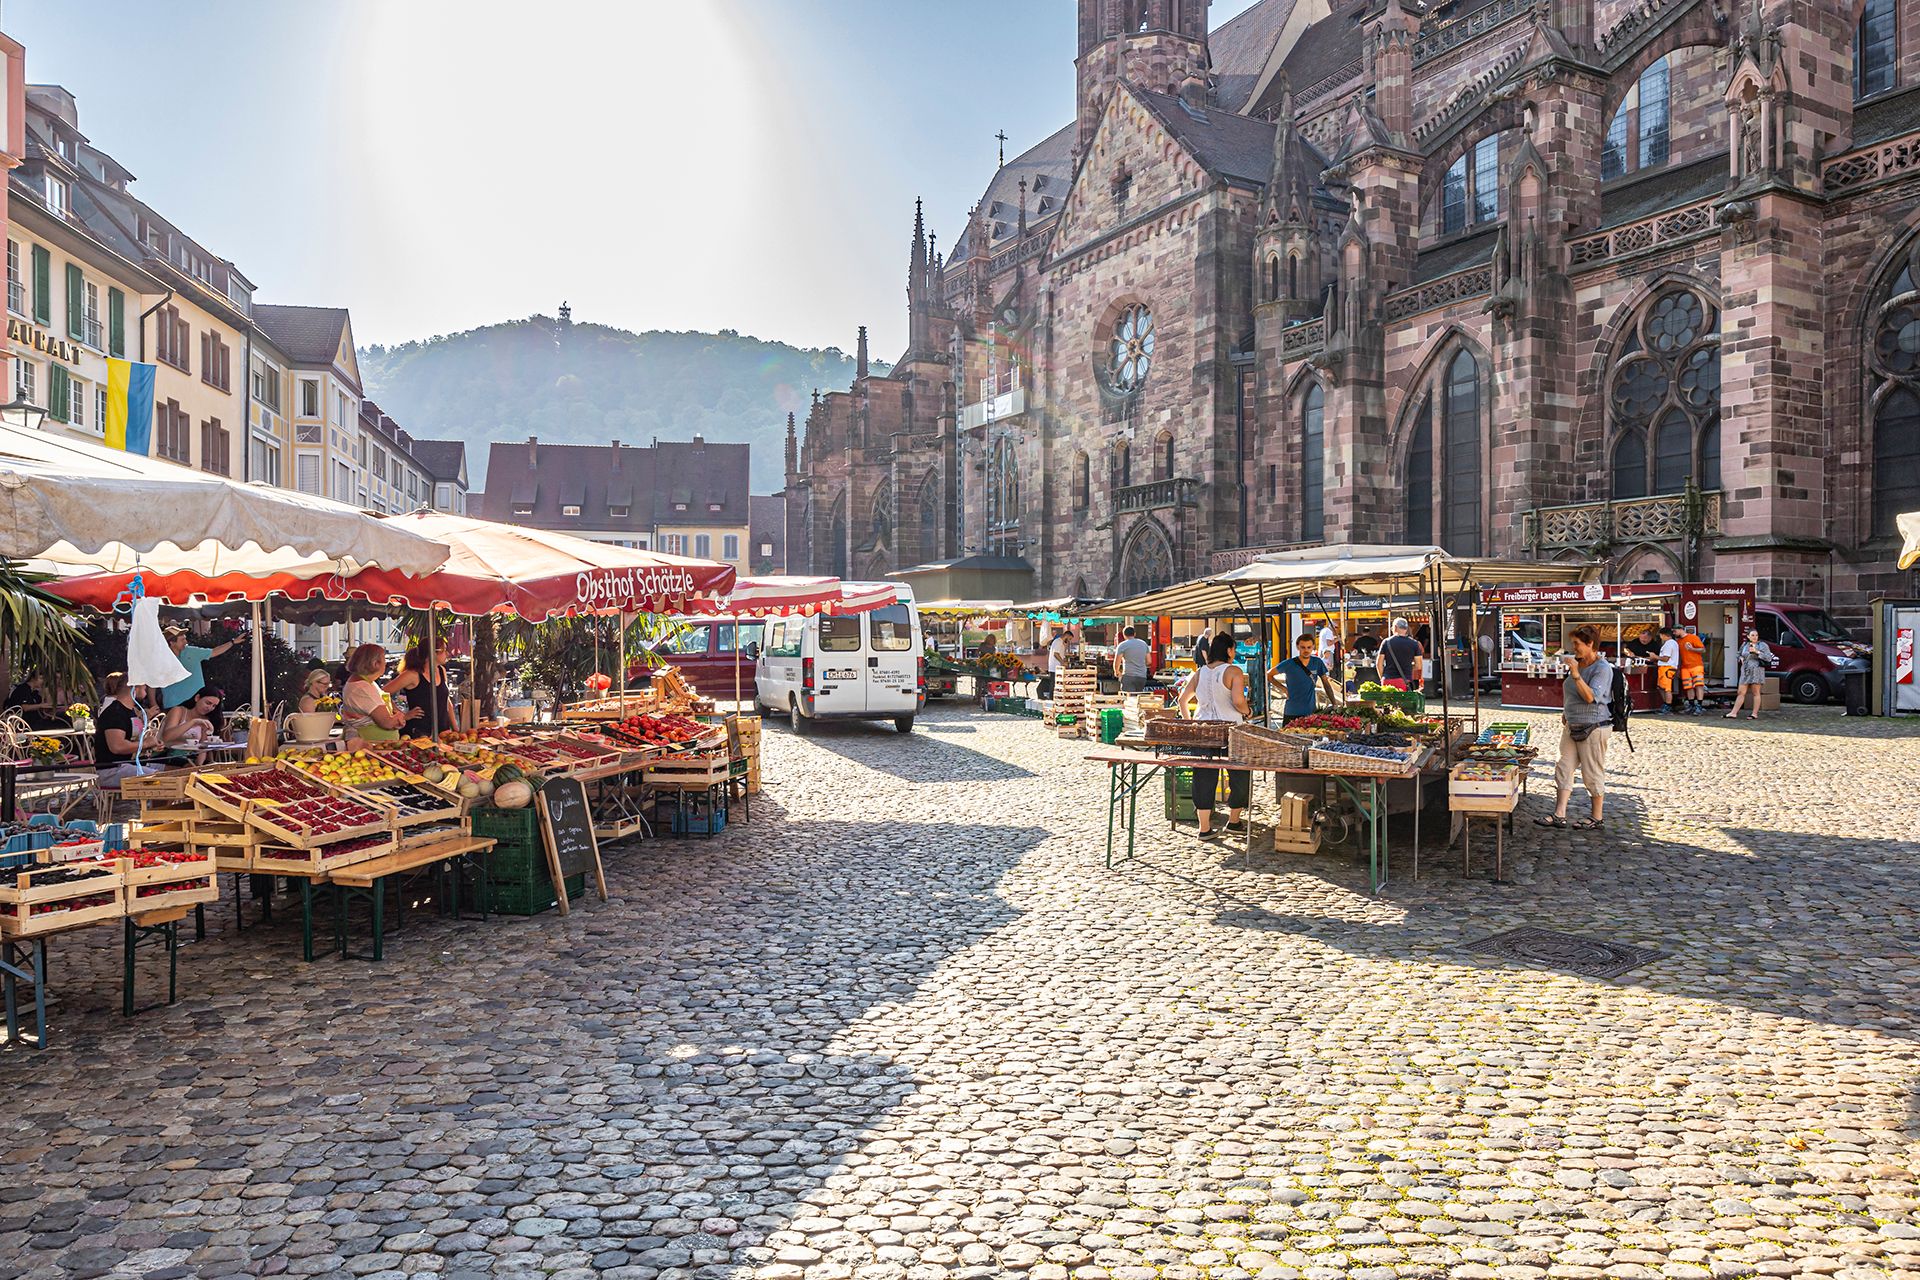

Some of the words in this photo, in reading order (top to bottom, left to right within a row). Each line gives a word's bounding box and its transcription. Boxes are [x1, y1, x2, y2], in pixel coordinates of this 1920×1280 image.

[576, 567, 634, 603] Obsthof
[636, 567, 695, 595] Schätzle
[1504, 592, 1539, 602] Freiburger
[1540, 591, 1561, 601] Lange
[1562, 590, 1579, 599] Rote
